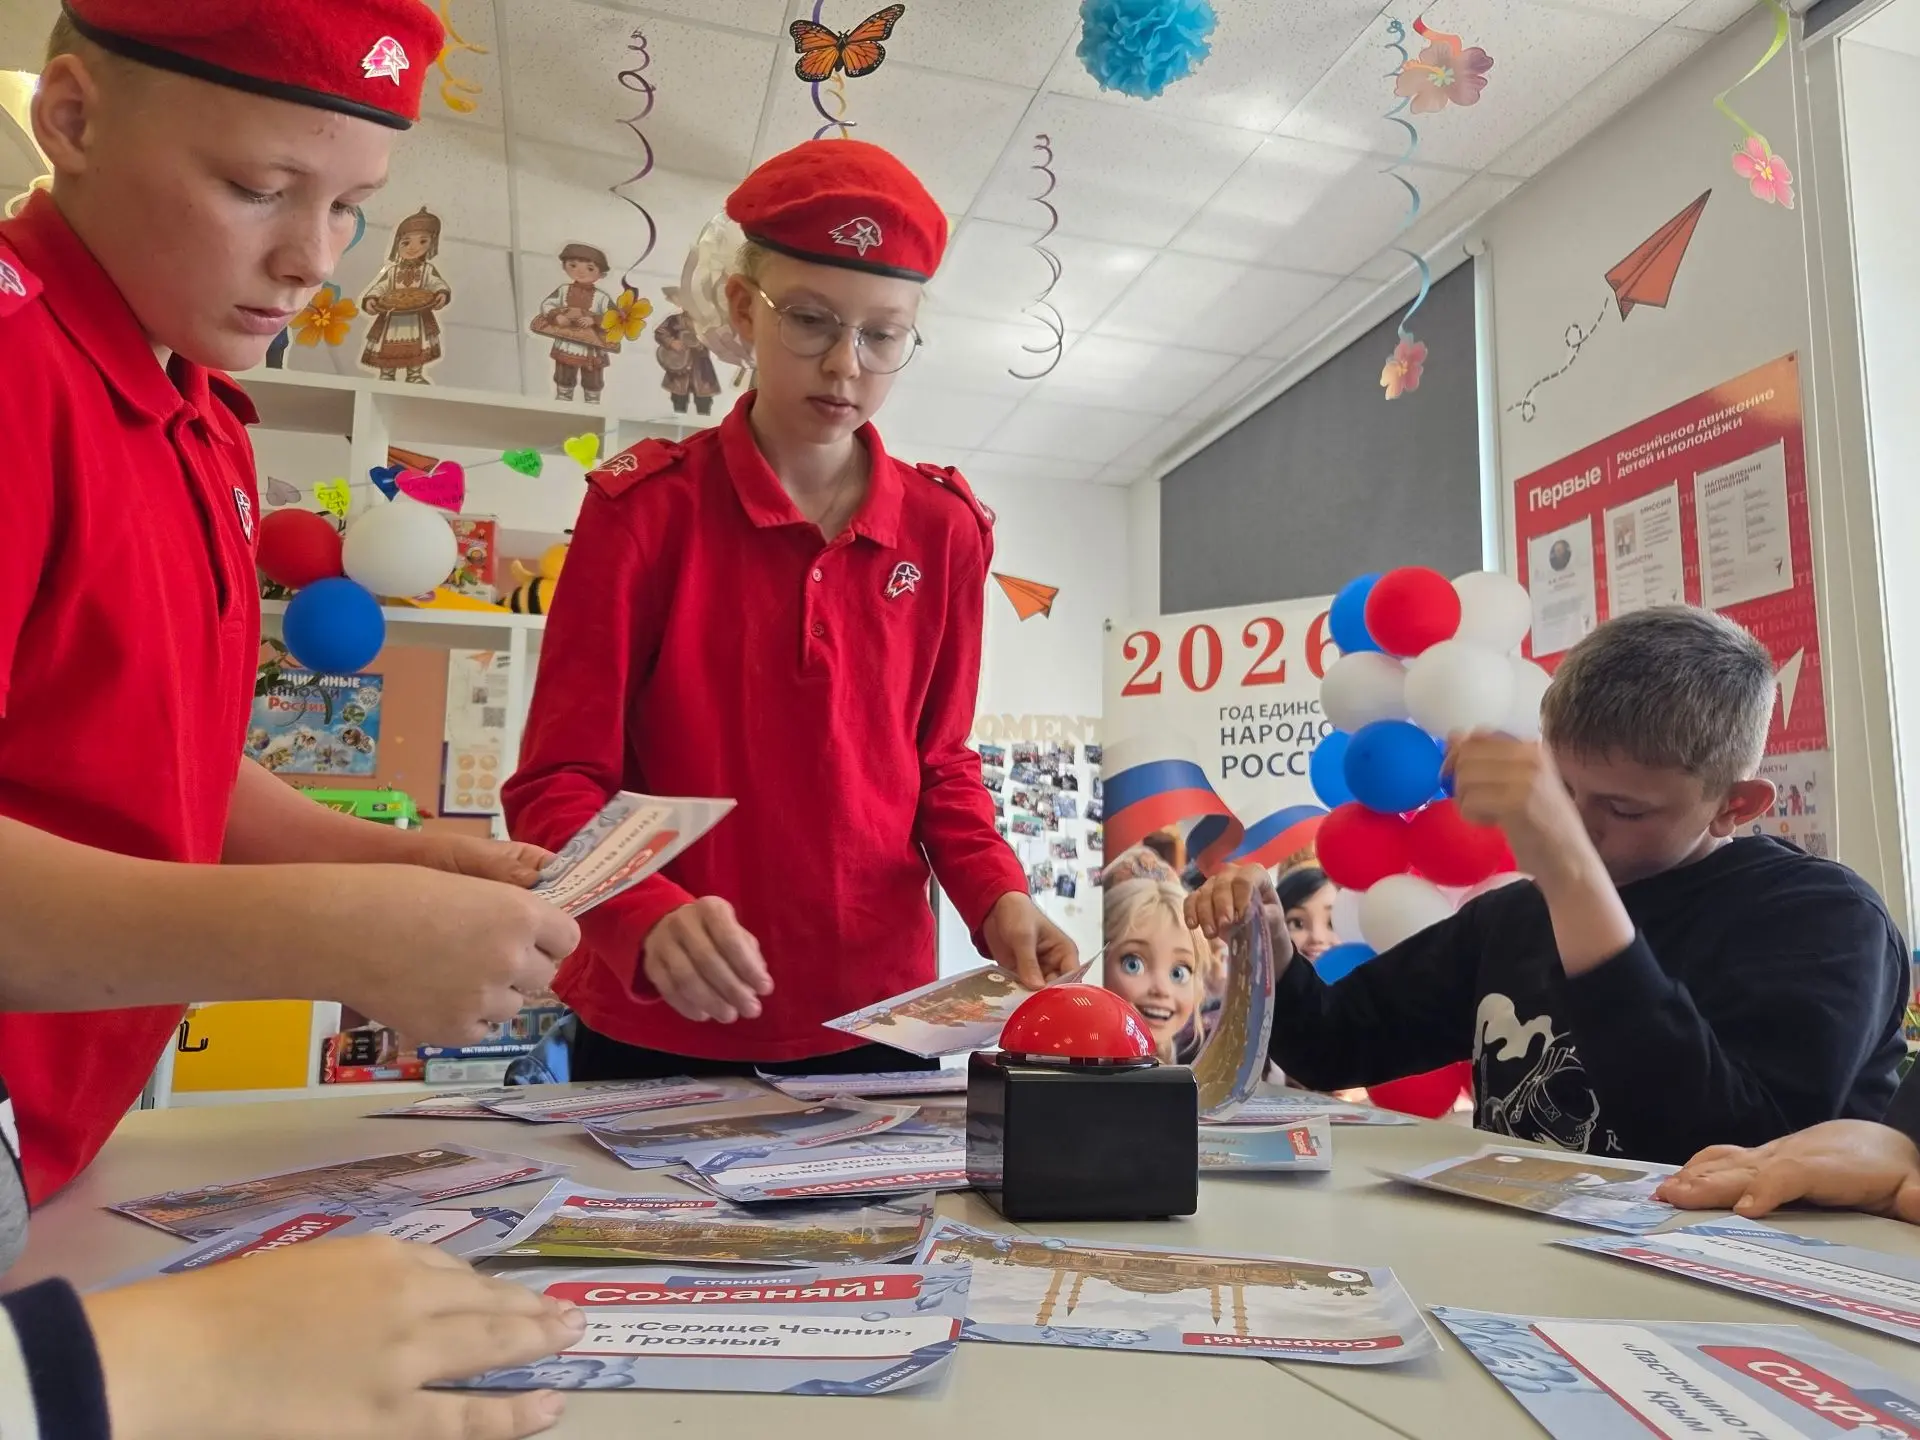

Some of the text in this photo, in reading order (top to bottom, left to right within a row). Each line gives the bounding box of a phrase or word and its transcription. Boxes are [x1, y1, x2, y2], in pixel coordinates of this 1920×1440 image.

[1616, 388, 1775, 464] Российское движение
[1617, 417, 1744, 479] детей и молодёжи
[1529, 465, 1602, 511] Первые
[1219, 703, 1254, 722] ГОД
[1221, 751, 1314, 779] РОСС
[794, 1170, 967, 1194] охраняй!
[584, 1200, 703, 1209] Сохраняй!
[184, 1239, 244, 1268] станция
[583, 1280, 886, 1304] Сохраняй!
[694, 1277, 792, 1286] станция
[592, 1333, 782, 1347] г. Грозный
[621, 1321, 770, 1334] «Сердце
[778, 1322, 914, 1337] Чечни»,
[1203, 1335, 1378, 1349] Сохраняй!
[865, 1364, 922, 1390] ПЕРВЫЕ
[1643, 1389, 1713, 1433] Крым
